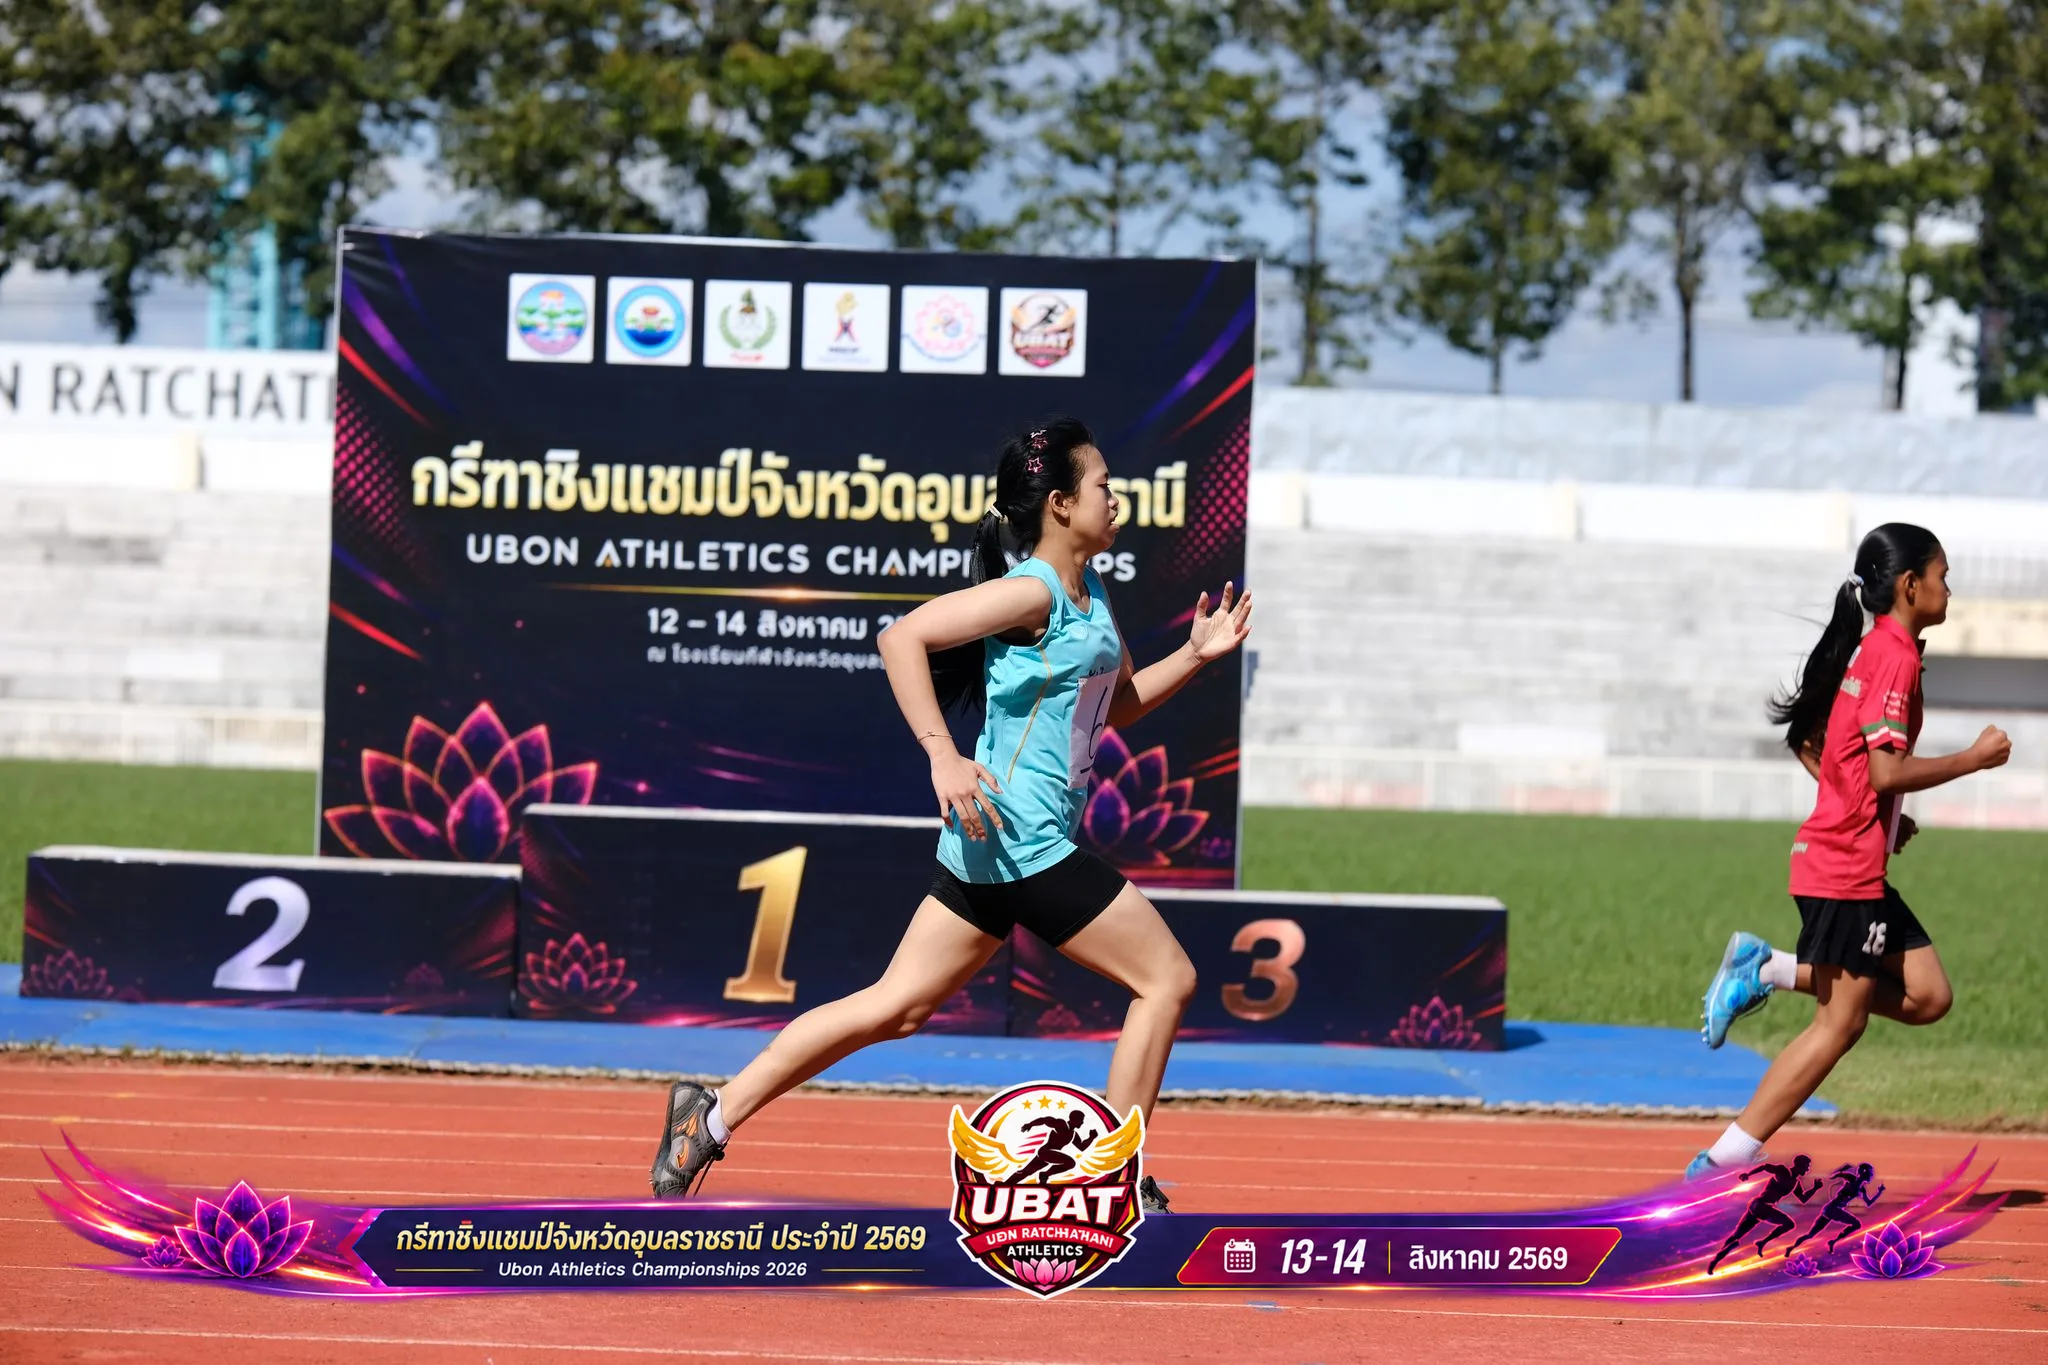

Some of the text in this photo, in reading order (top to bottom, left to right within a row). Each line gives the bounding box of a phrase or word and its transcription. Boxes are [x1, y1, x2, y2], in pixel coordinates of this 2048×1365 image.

[466, 533, 580, 567] UBON
[595, 539, 811, 574] ATHLETICS
[647, 607, 680, 635] 12
[715, 610, 748, 637] 14
[757, 609, 868, 640] สิงหาคม
[212, 875, 312, 993] 2
[724, 846, 809, 1004] 1
[1221, 918, 1307, 1022] 3
